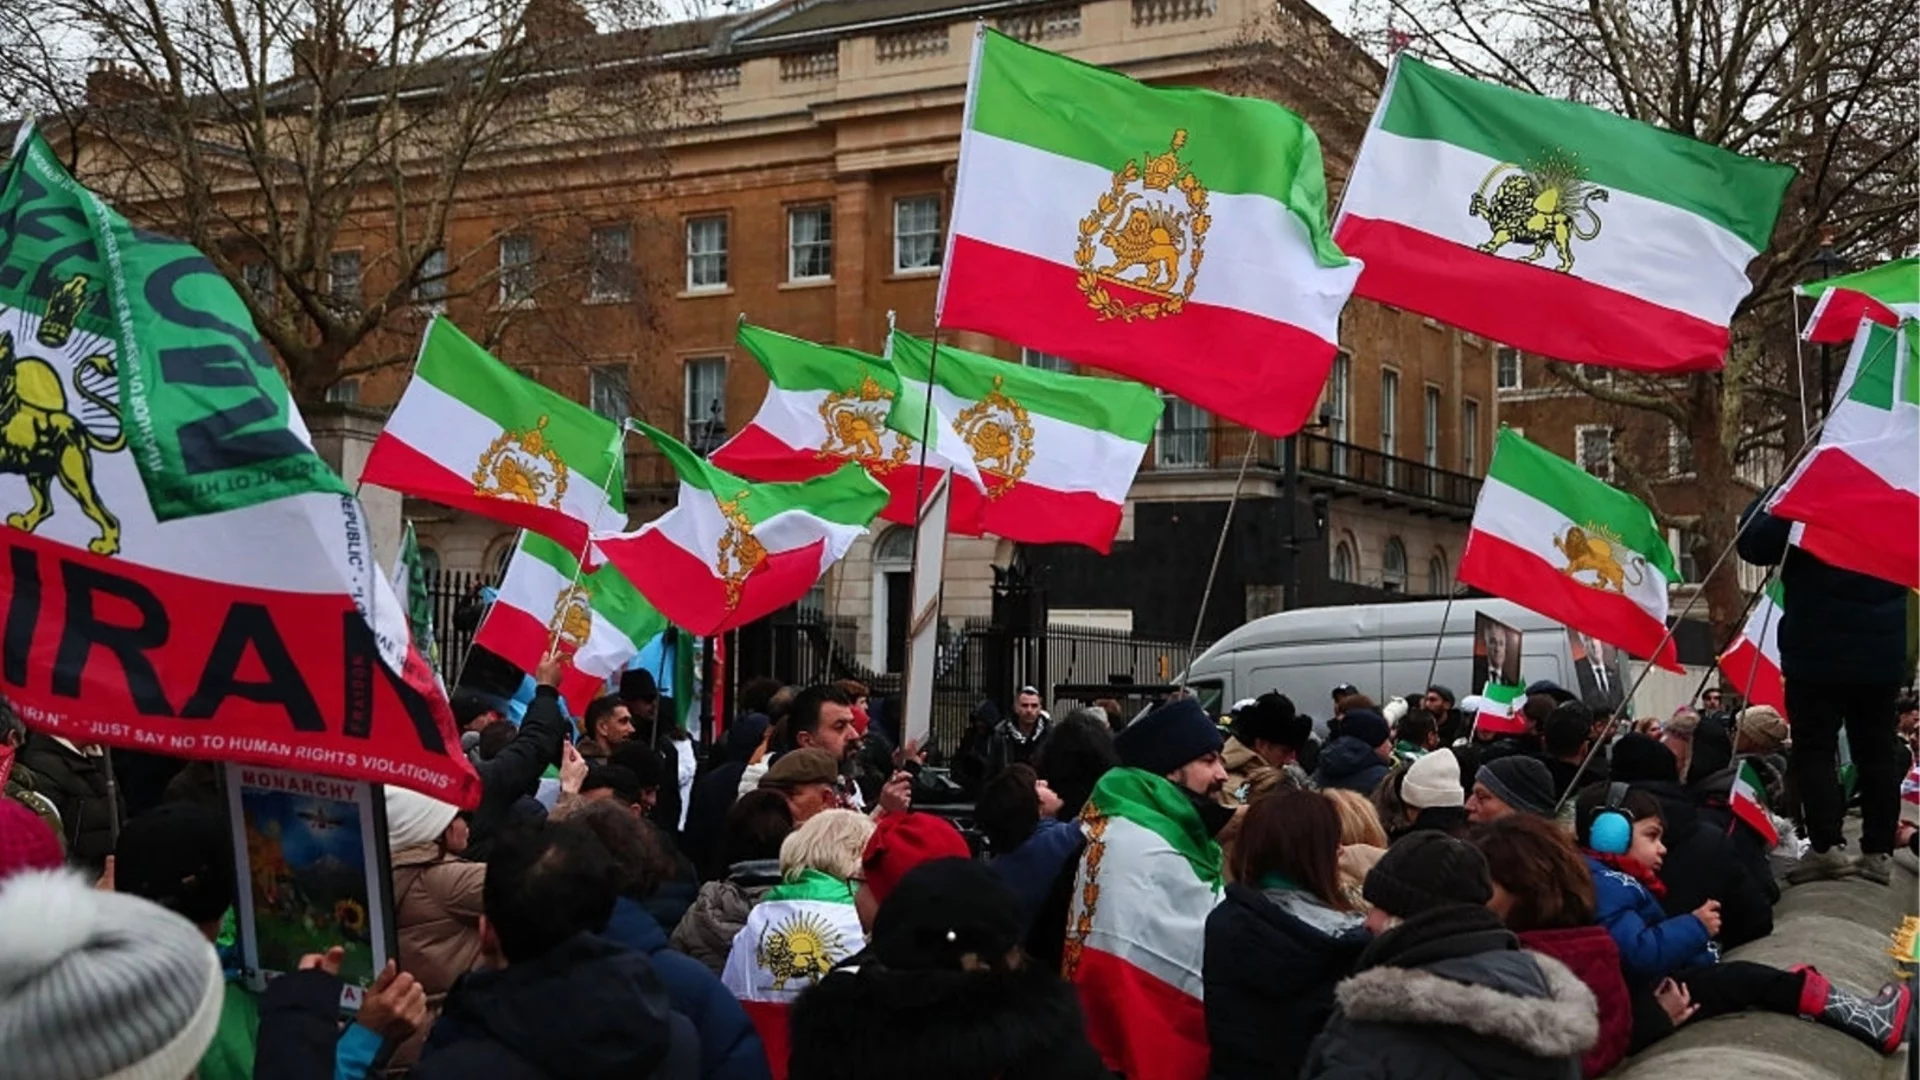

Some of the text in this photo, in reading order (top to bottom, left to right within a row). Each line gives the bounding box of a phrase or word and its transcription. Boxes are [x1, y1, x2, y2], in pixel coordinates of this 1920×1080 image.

[3, 545, 447, 755] IRAN
[134, 729, 165, 744] SAY
[171, 735, 194, 749] NO
[203, 735, 225, 750] TO
[229, 736, 292, 757] HUMAN
[295, 746, 357, 767] RIGHTS
[241, 770, 357, 799] MONARCHY
